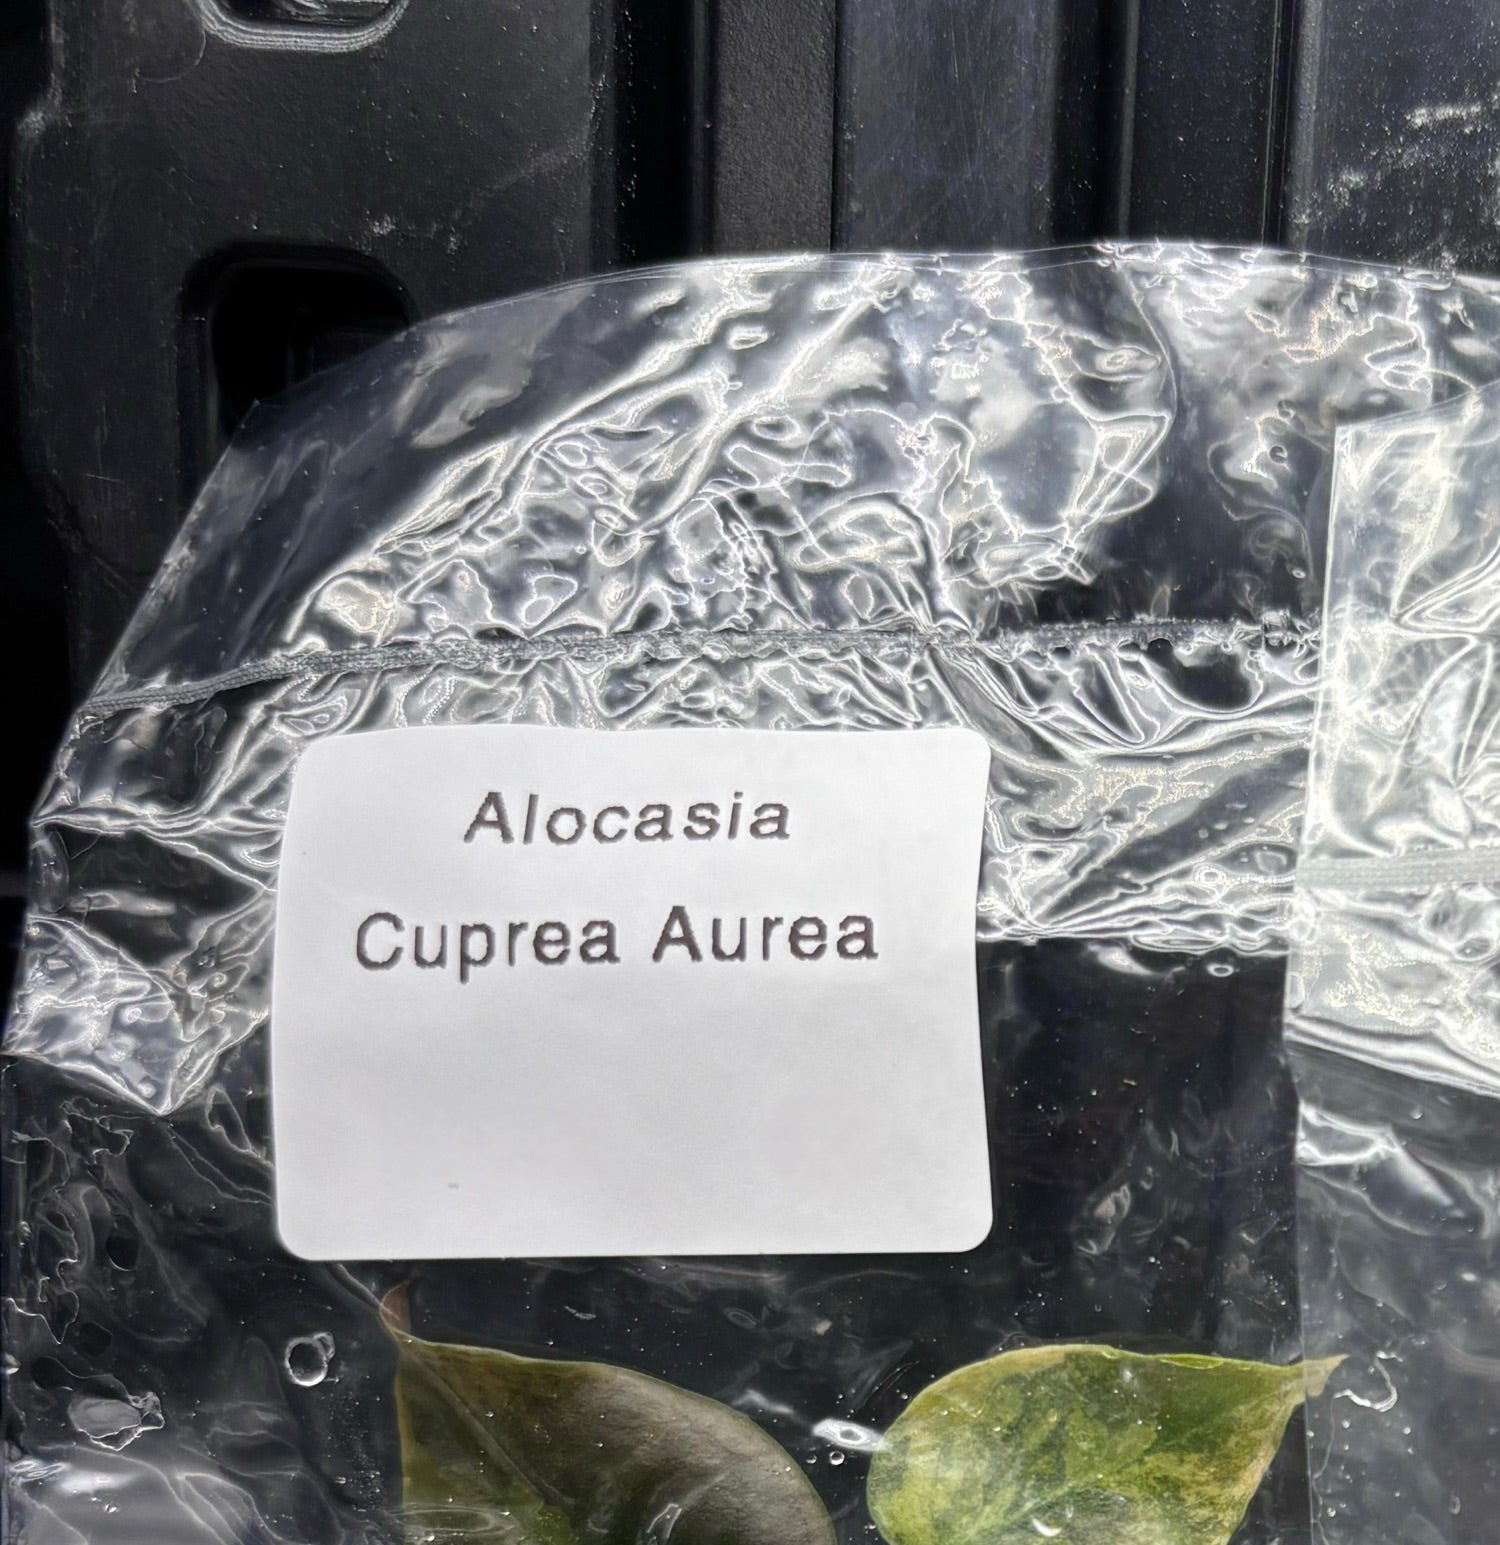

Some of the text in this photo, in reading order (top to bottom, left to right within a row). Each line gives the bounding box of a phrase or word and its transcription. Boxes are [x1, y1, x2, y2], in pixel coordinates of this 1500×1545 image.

[463, 791, 791, 846] Alocasia
[355, 904, 880, 985] Cuprea Aurea
